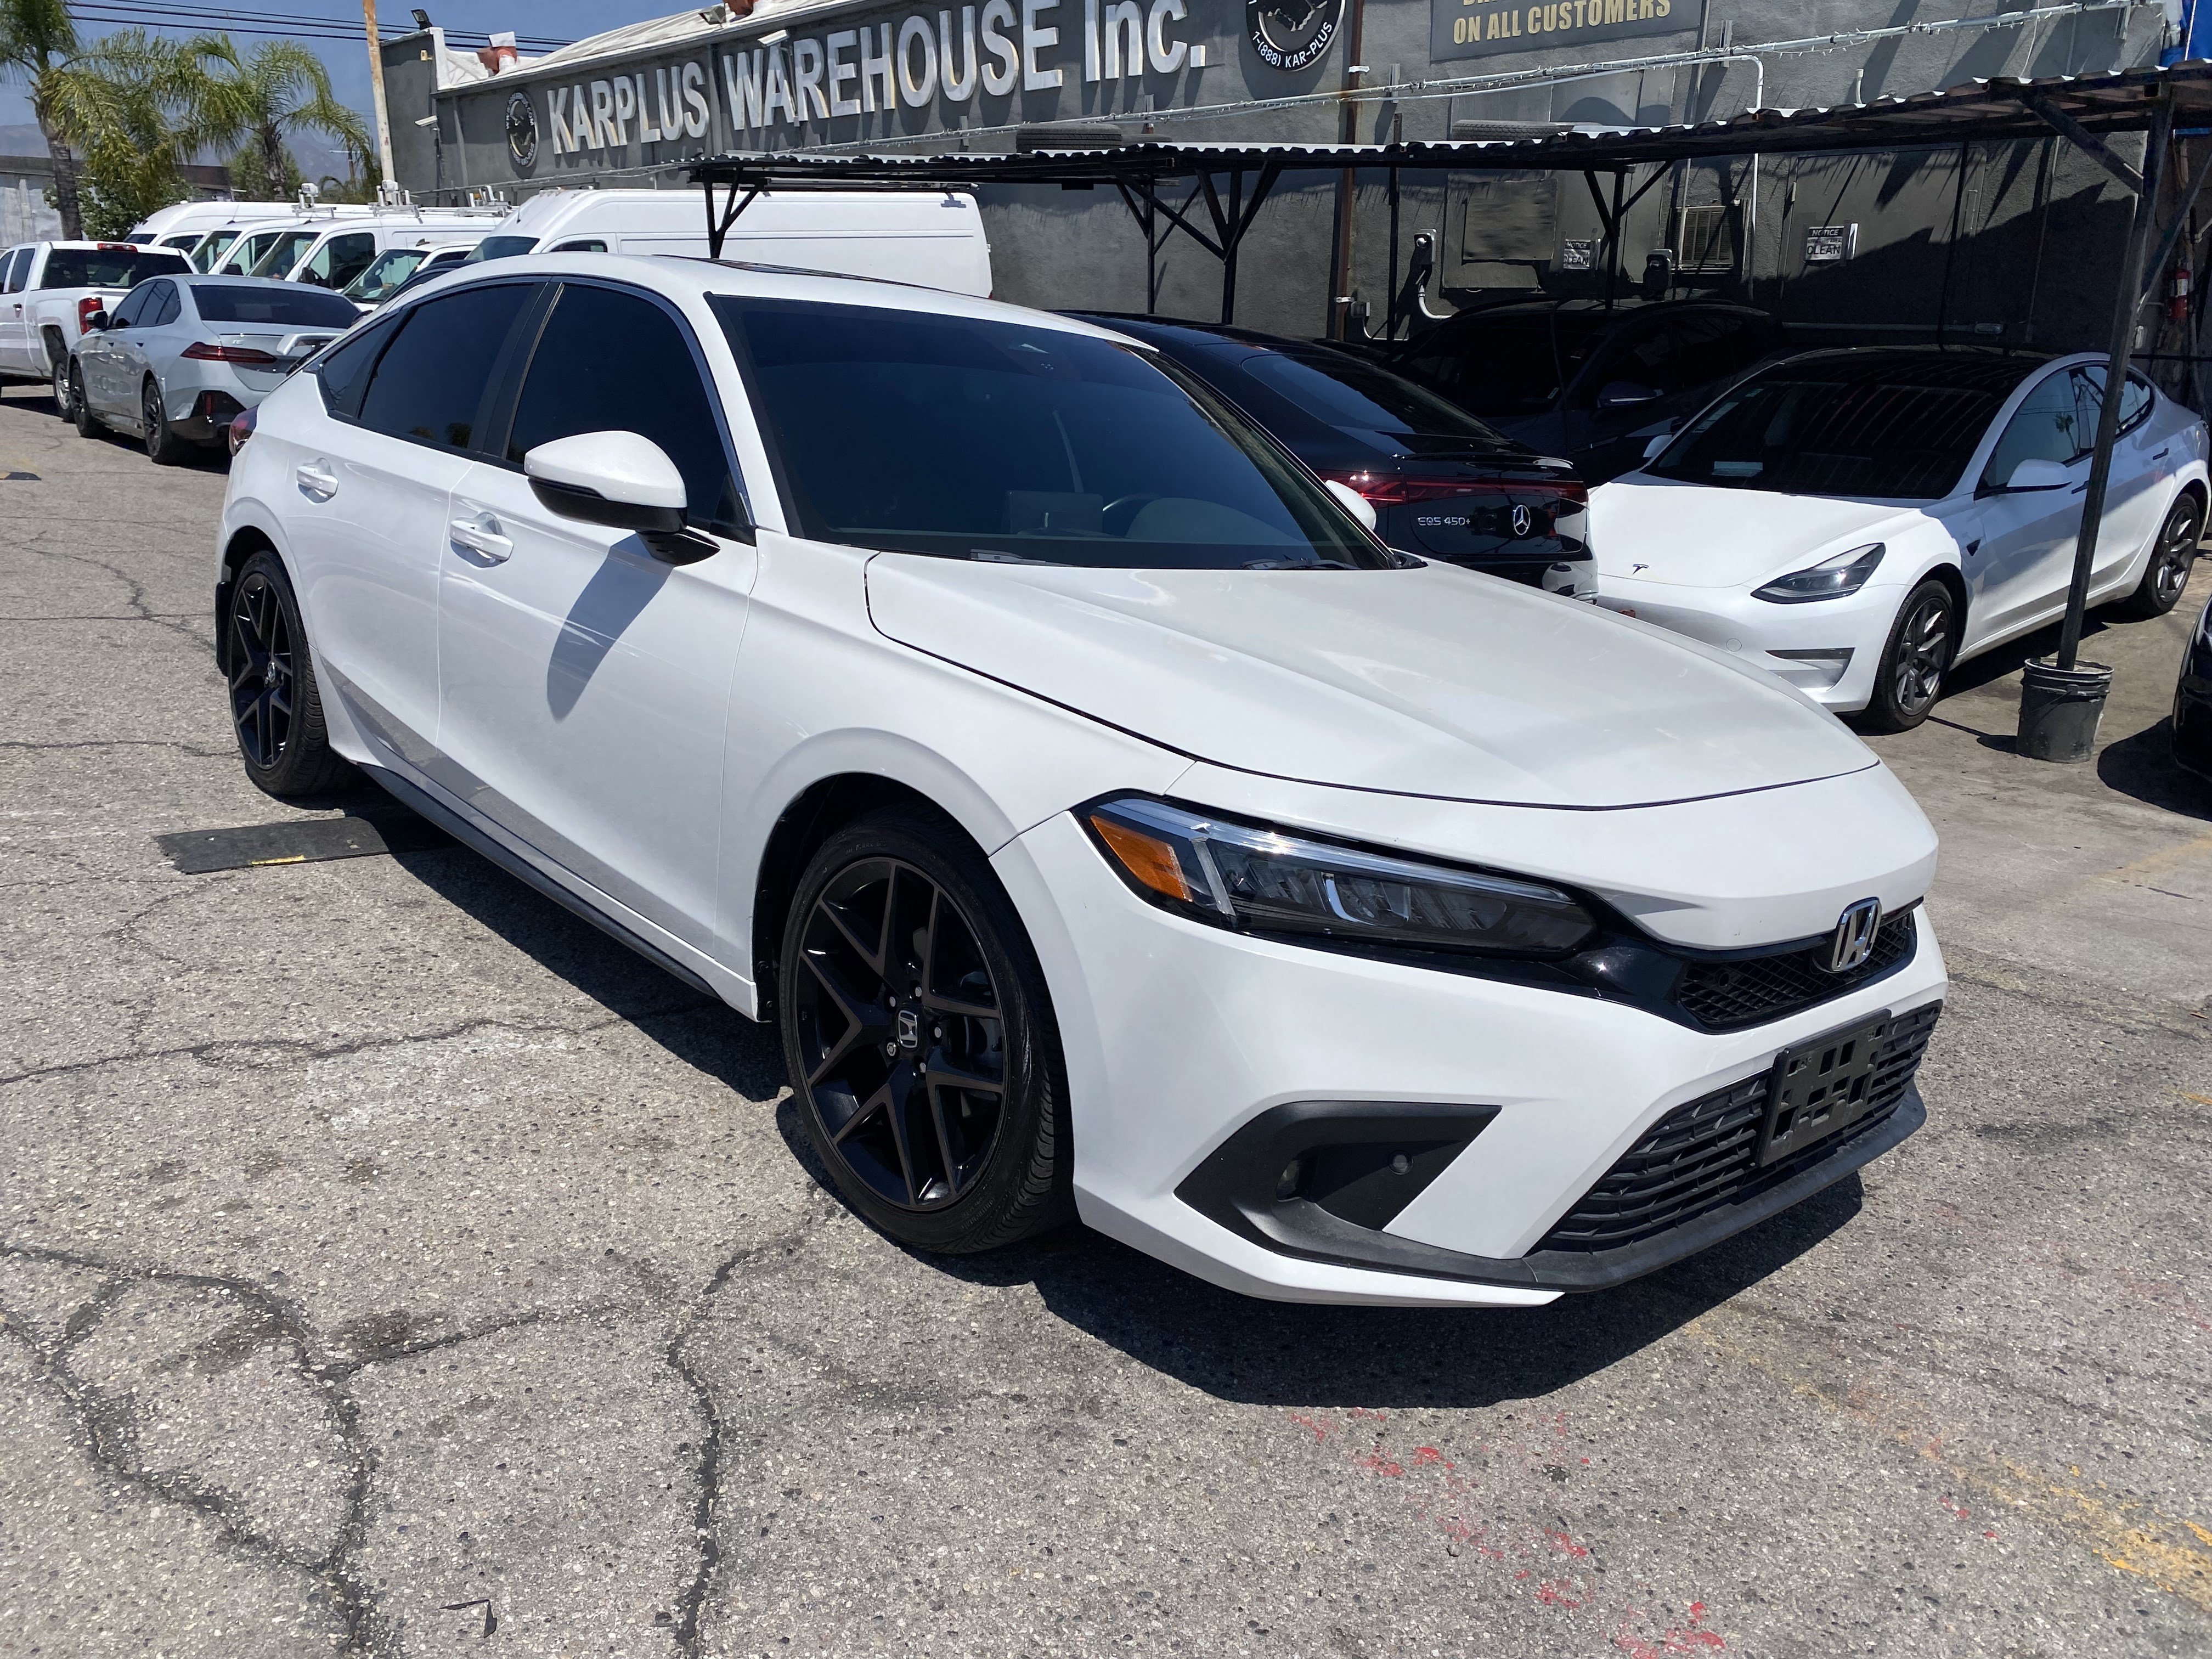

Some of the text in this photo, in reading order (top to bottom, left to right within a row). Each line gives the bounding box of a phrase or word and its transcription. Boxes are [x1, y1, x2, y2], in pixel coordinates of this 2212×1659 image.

[1252, 21, 1332, 67] 1-(888) KAR-PLUS
[1454, 0, 1671, 44] ON ALL CUSTOMERS
[547, 62, 709, 154] KARPLUS
[723, 0, 1062, 131] WAREHOUSE
[1085, 0, 1205, 82] Inc.
[1807, 244, 1841, 255] CLEAN
[1418, 517, 1471, 526] EQS 450+
